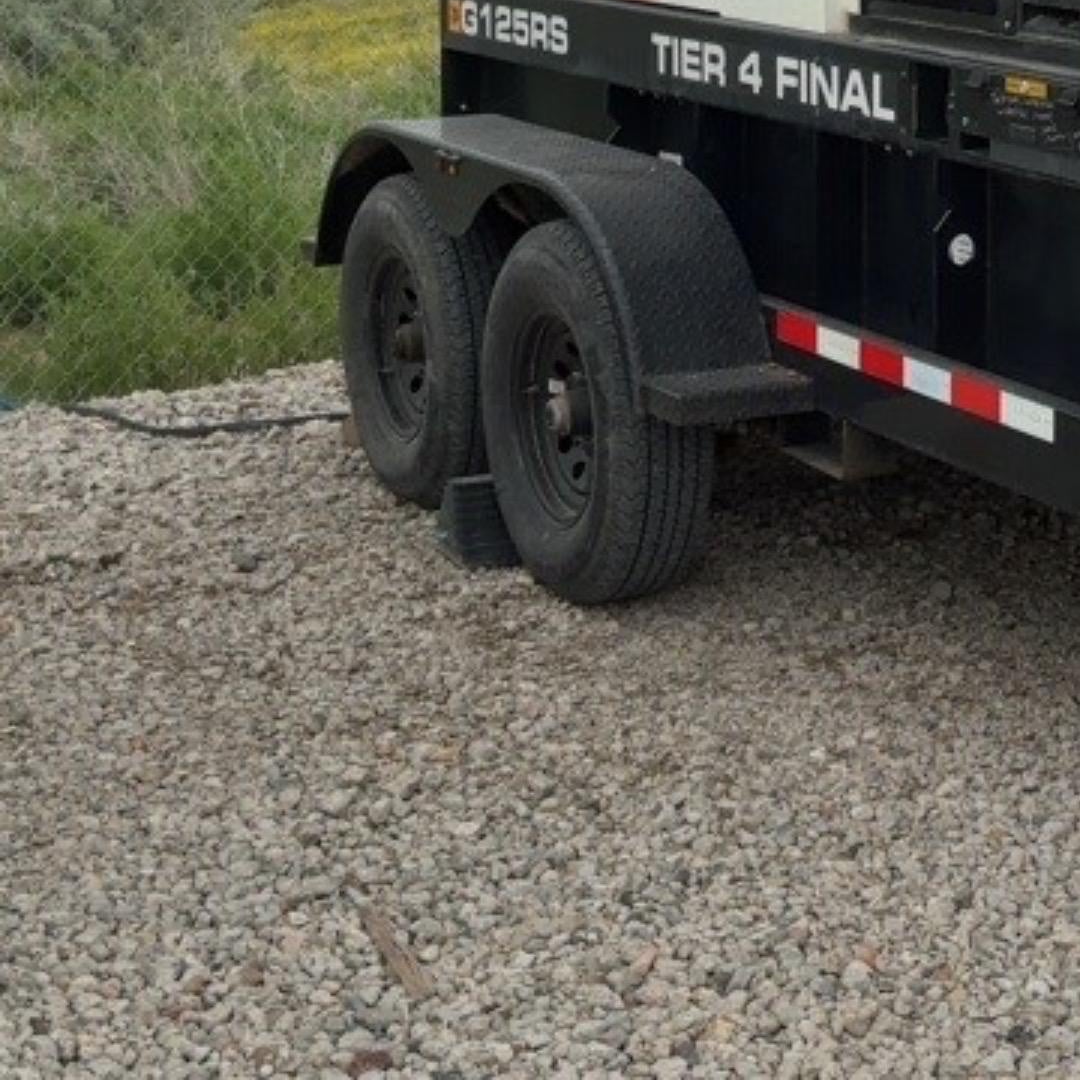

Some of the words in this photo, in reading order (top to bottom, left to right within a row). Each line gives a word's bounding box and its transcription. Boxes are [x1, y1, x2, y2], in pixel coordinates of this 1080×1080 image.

[651, 32, 727, 87] TIER
[737, 51, 763, 94] 4
[776, 56, 896, 121] FINAL
